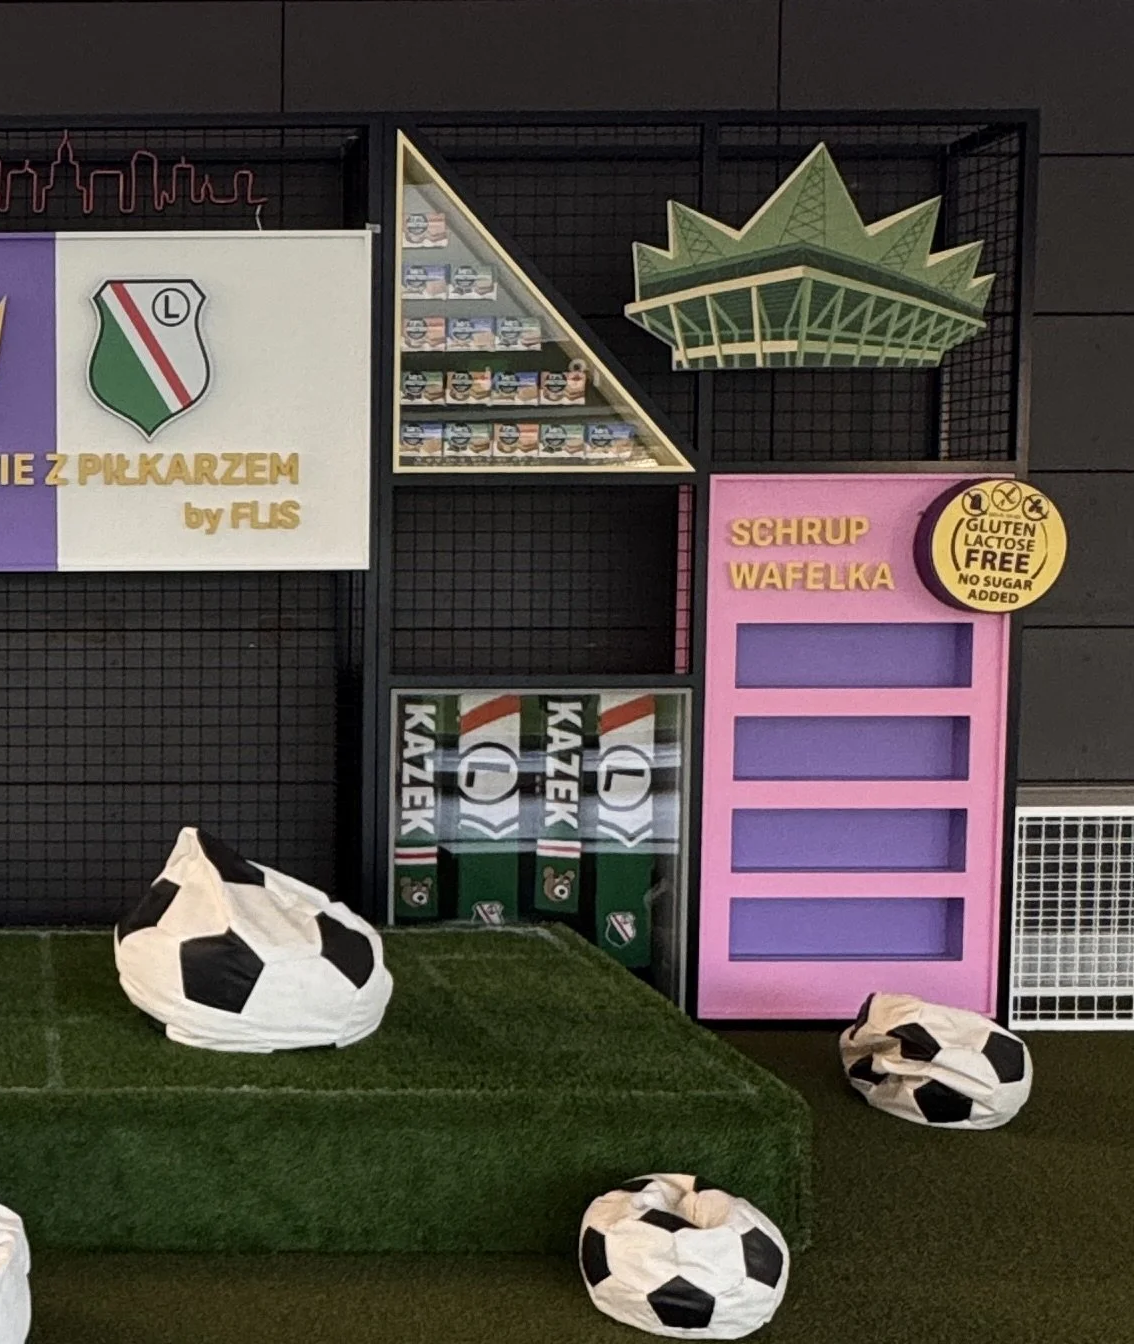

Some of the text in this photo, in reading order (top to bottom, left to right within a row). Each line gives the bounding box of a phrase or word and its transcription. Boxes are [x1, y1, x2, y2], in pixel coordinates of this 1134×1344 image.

[164, 294, 180, 319] L
[44, 452, 69, 486] Z
[78, 452, 299, 486] PIŁKARZEM
[184, 500, 301, 535] by FLIS
[730, 515, 870, 547] SCHRUP
[965, 517, 1036, 537] GLUTEN
[964, 534, 1035, 552] LACTOSE
[964, 548, 1031, 574] FREE
[729, 561, 895, 591] WAFELKA
[958, 573, 1033, 591] NO SUGAR
[967, 589, 1019, 604] ADDED
[401, 704, 436, 835] KAZEK
[544, 701, 583, 829] KAZEK
